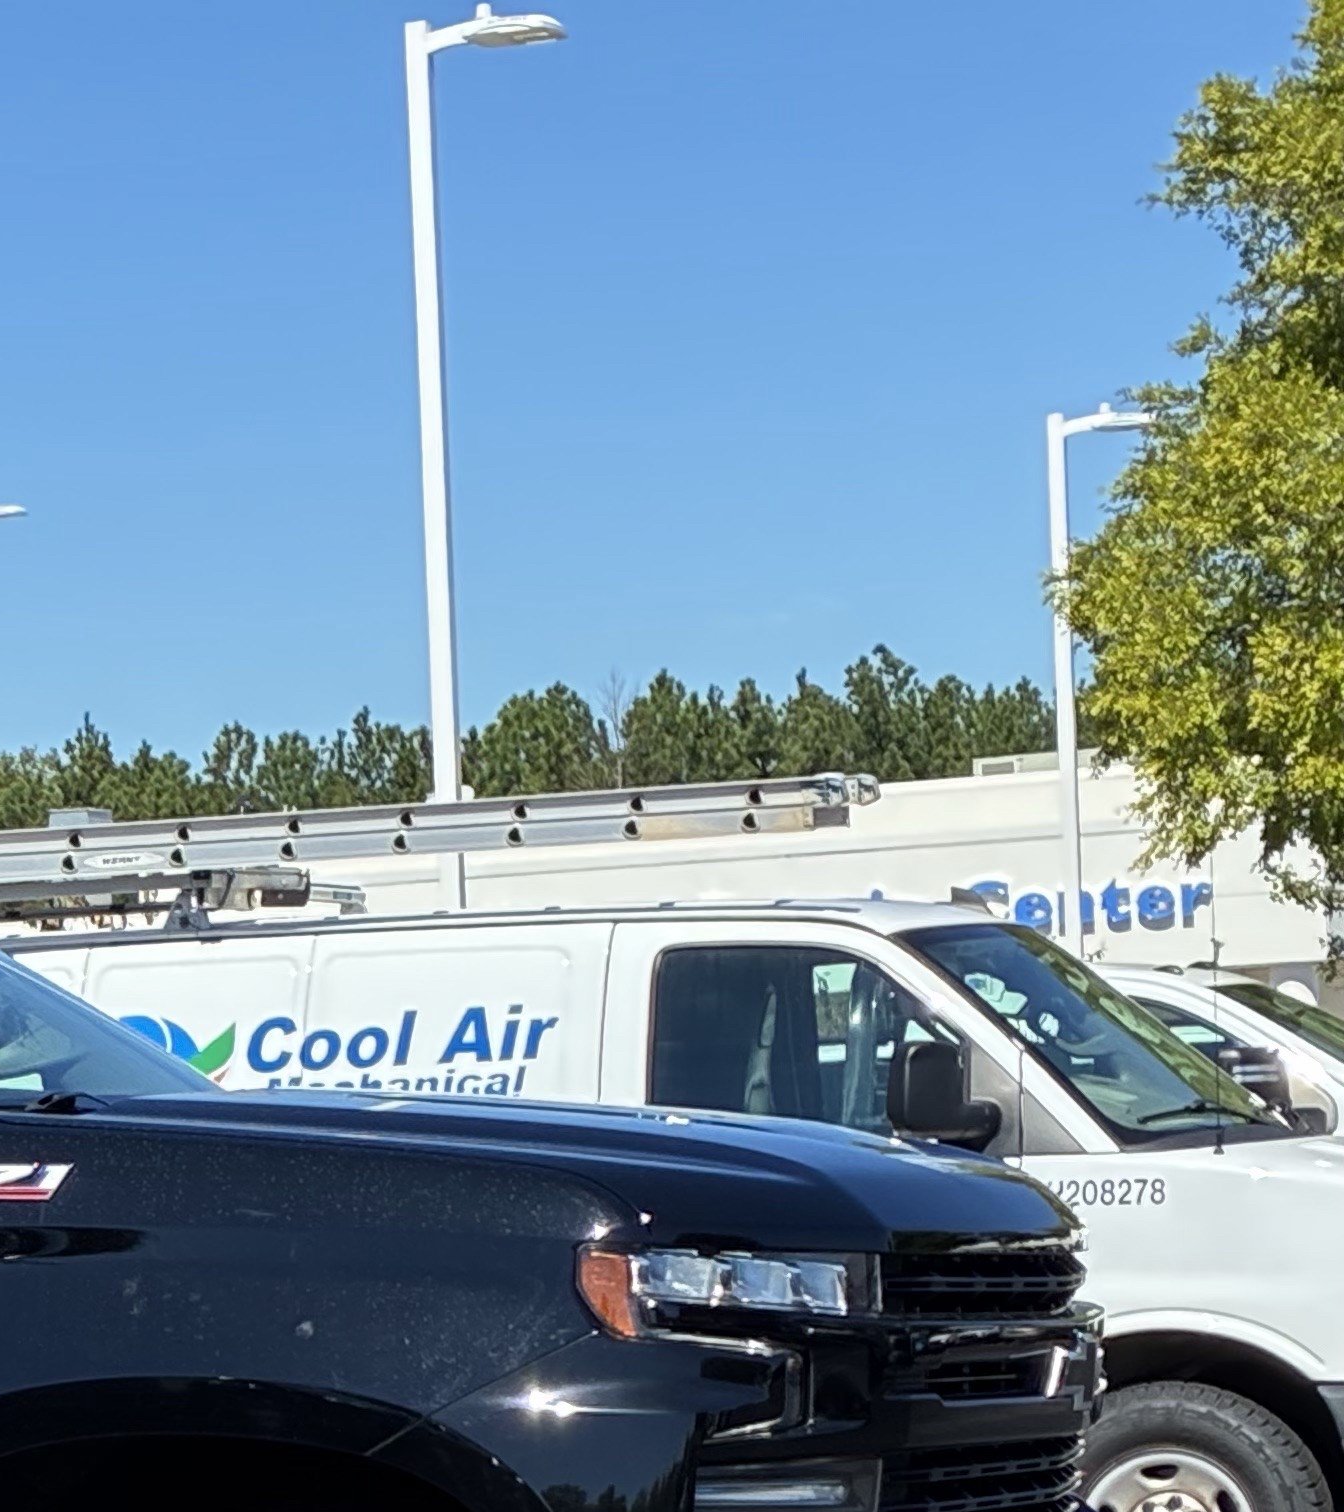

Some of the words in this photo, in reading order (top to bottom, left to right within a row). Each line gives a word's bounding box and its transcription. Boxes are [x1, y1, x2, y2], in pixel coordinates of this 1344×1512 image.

[246, 1009, 417, 1074] Cool
[438, 1004, 559, 1064] Air
[268, 1065, 526, 1097] hanical
